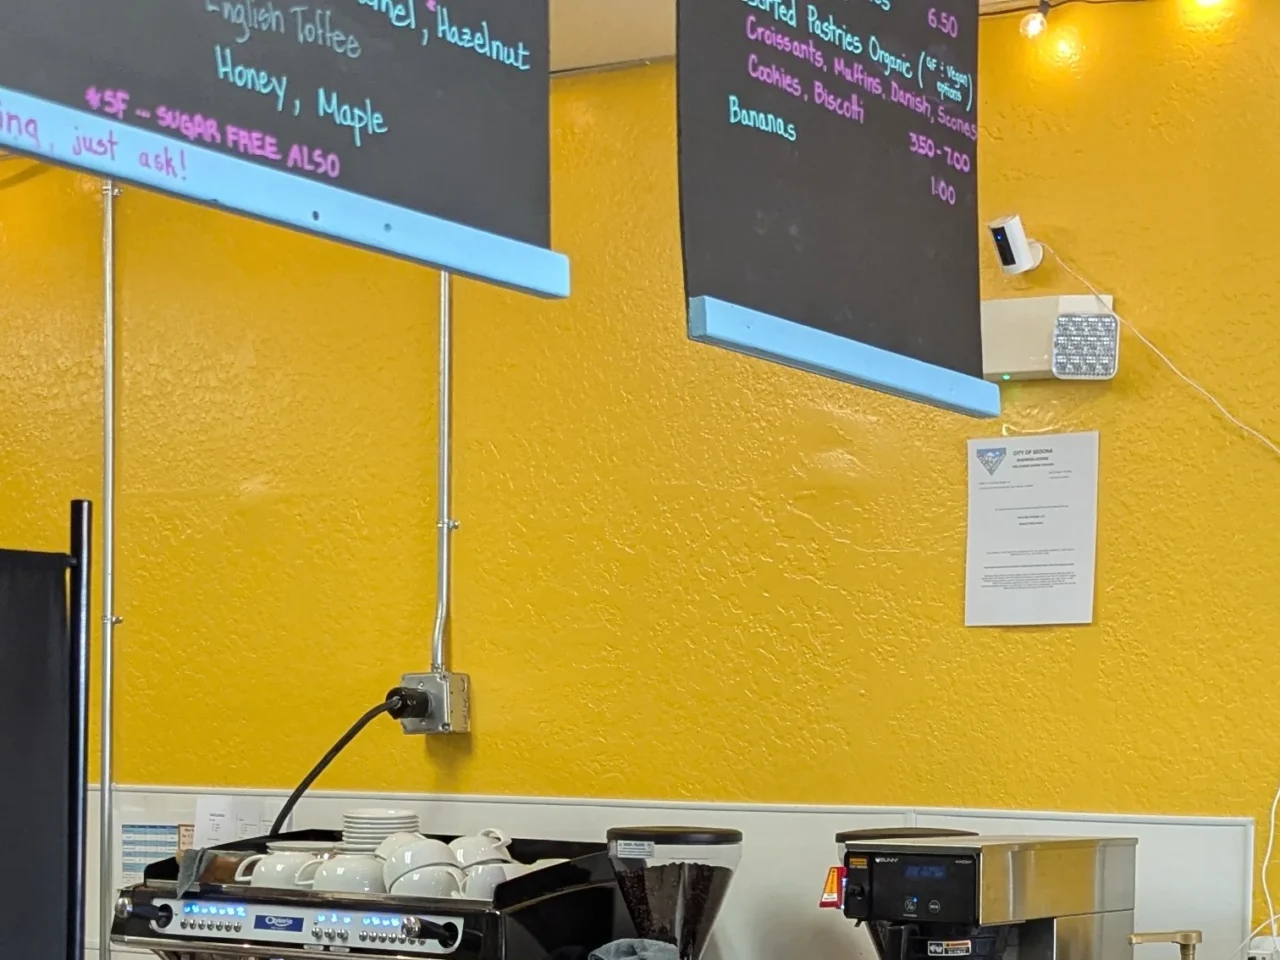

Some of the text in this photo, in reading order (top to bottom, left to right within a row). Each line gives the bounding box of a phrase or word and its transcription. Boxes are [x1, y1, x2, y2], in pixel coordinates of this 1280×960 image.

[290, 7, 362, 58] Toffee
[435, 5, 531, 71] Hazelnut
[806, 4, 863, 54] Pastries
[868, 35, 913, 78] Organic
[926, 7, 958, 38] 6.50
[317, 87, 388, 148] Maple
[728, 94, 797, 142] Bananas
[813, 80, 865, 124] Biscotti
[937, 106, 978, 141] Scones
[71, 125, 119, 161] just
[138, 148, 188, 181] ask!
[155, 105, 221, 144] SUGAR
[225, 123, 283, 161] FREE
[286, 142, 341, 179] ALSO
